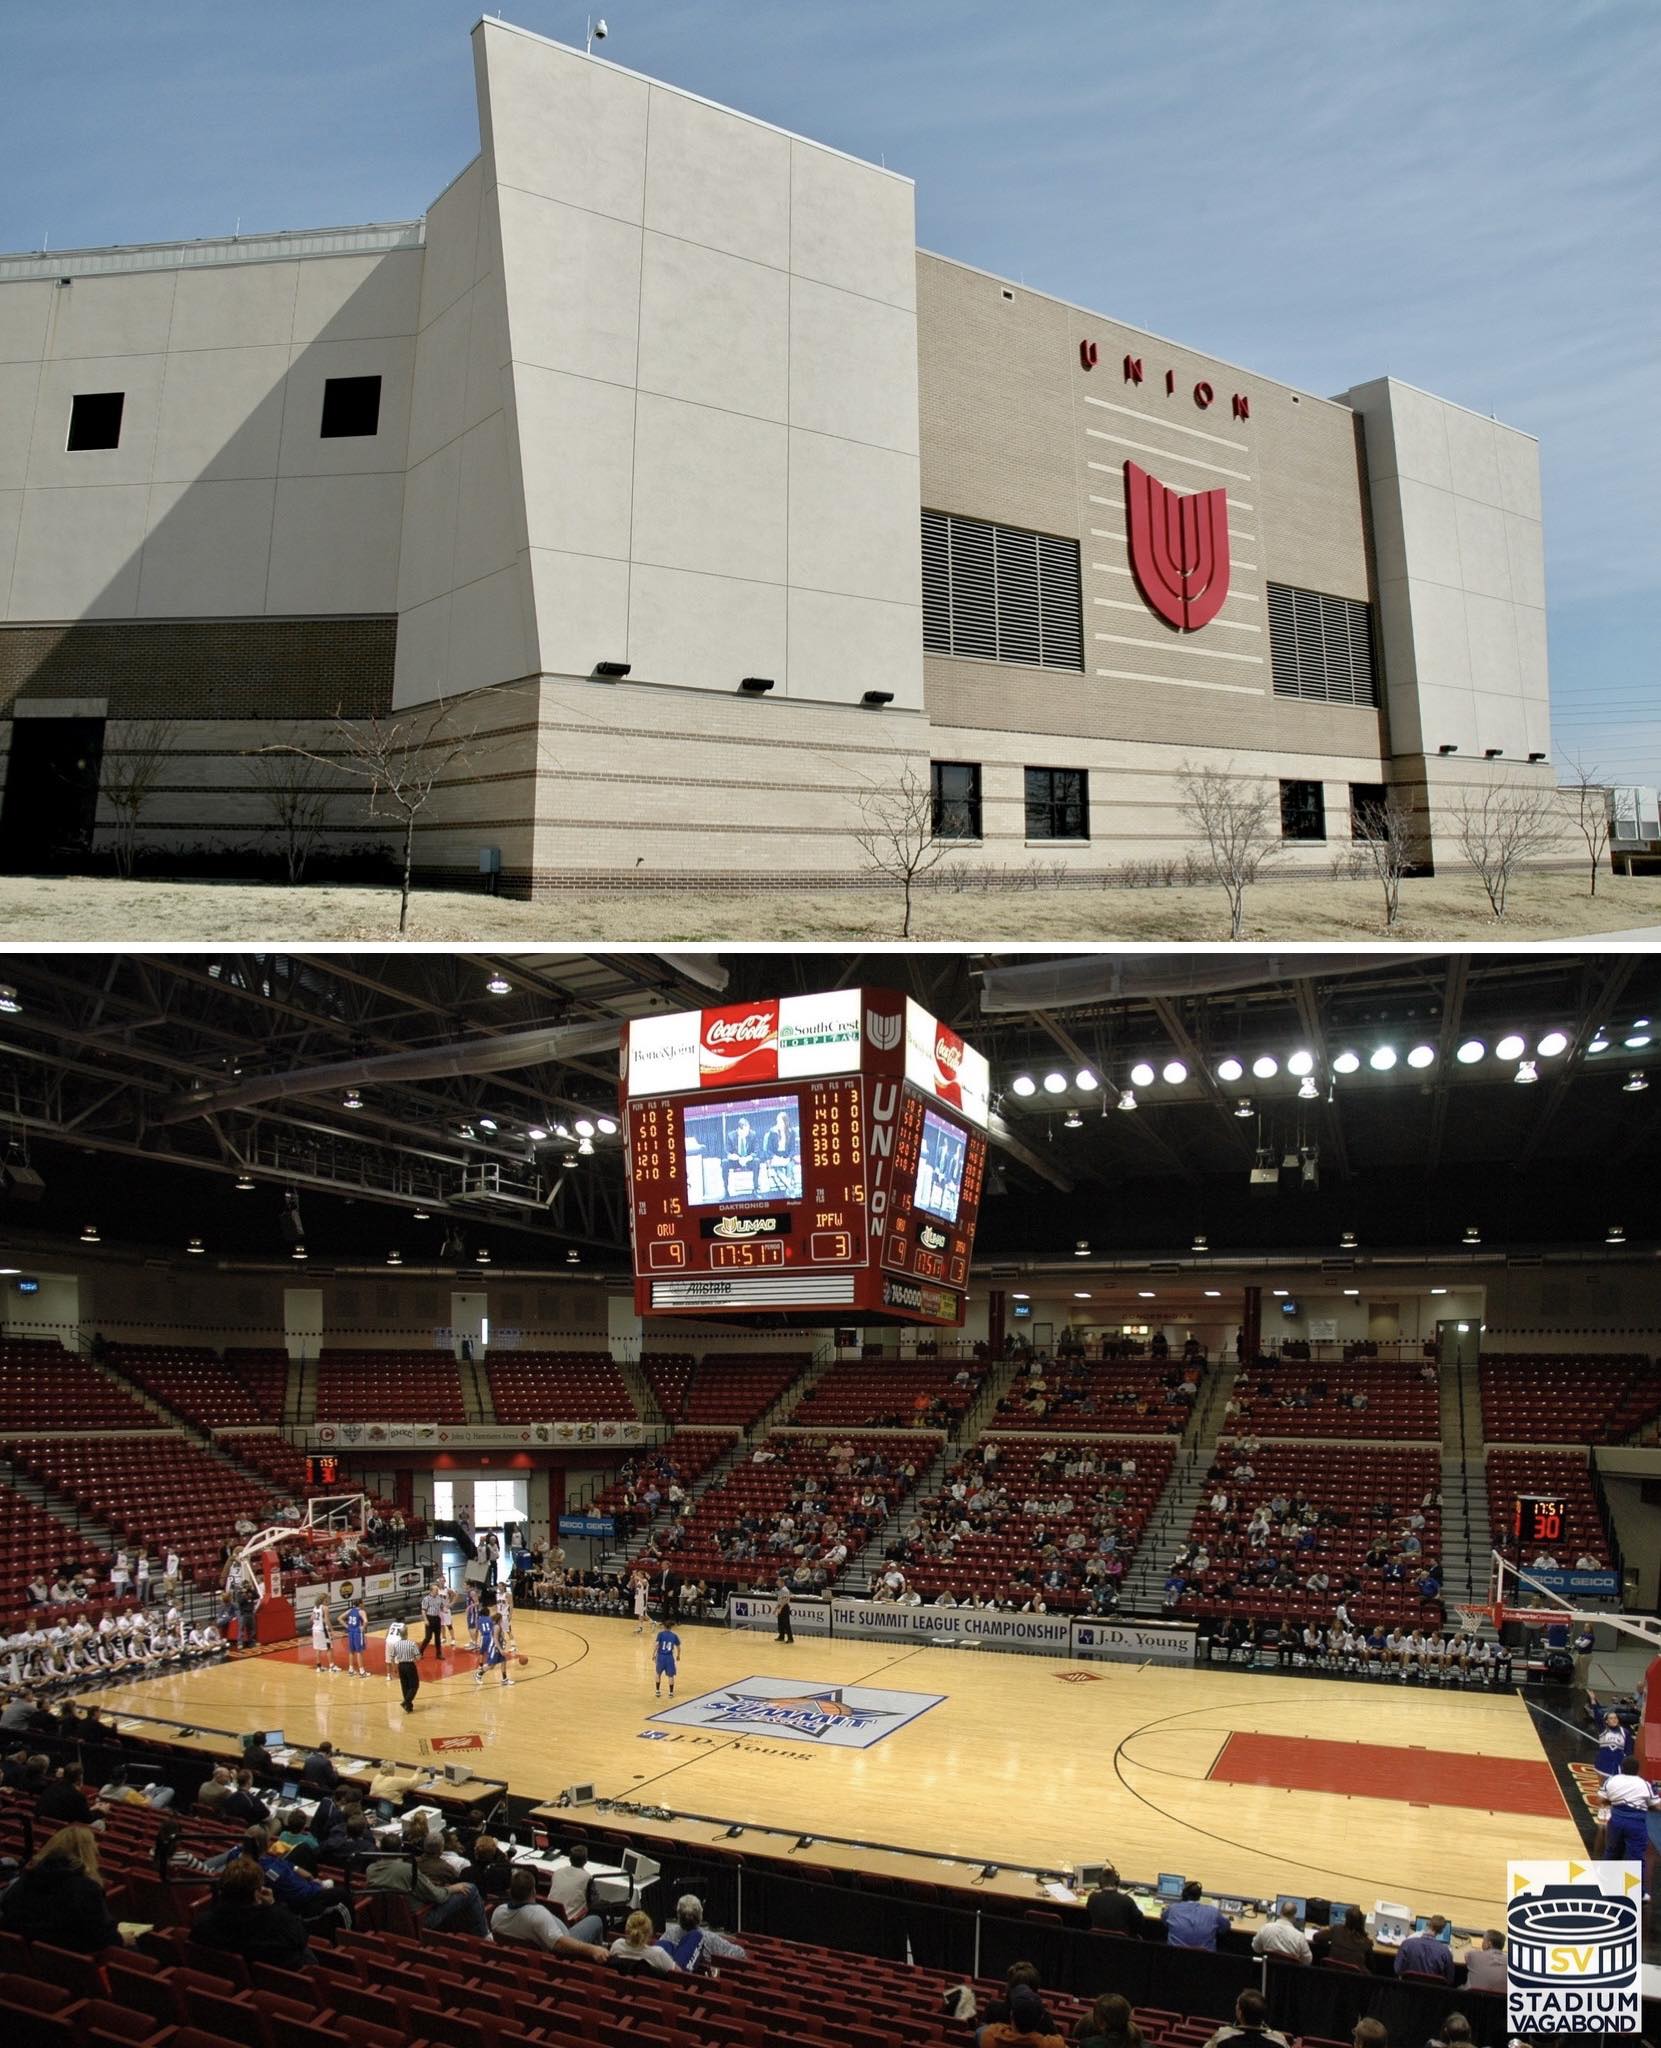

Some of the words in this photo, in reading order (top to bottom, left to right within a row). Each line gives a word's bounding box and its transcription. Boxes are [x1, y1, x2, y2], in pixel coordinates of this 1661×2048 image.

[1080, 340, 1249, 420] UNION
[707, 1013, 774, 1045] Coca-Cola
[795, 1020, 859, 1035] SouthCrest
[780, 1033, 859, 1048] HOSPITAL
[851, 1090, 858, 1103] 3
[667, 1109, 673, 1122] 2
[816, 1109, 827, 1120] 14
[831, 1107, 838, 1119] 0
[851, 1105, 858, 1118] 0
[667, 1124, 674, 1135] 2
[812, 1123, 827, 1136] 23
[832, 1122, 839, 1135] 0
[851, 1121, 859, 1133] 0
[668, 1138, 675, 1150] 0
[814, 1138, 828, 1151] 33
[832, 1138, 839, 1150] 0
[852, 1136, 859, 1148] 0
[638, 1155, 648, 1166] 12
[652, 1154, 659, 1166] 0
[669, 1152, 676, 1164] 3
[814, 1154, 828, 1166] 35
[833, 1153, 840, 1165] 0
[852, 1151, 860, 1163] 0
[871, 1083, 898, 1236] UNION
[669, 1166, 676, 1178] 2
[719, 1202, 769, 1211] DAKTRONICS
[816, 1213, 843, 1227] IPFW
[657, 1223, 675, 1236] ORU
[835, 1236, 846, 1256] 3
[670, 1245, 680, 1263] 9
[720, 1244, 765, 1265] 17:51
[687, 1282, 732, 1294] Allstate
[1534, 1502, 1564, 1515] 17:51
[1534, 1516, 1560, 1538] 30
[1570, 1577, 1615, 1587] GEICO
[789, 1605, 824, 1622] oung
[834, 1609, 855, 1624] THE
[859, 1611, 909, 1629] SUMMIT
[913, 1615, 961, 1632] LEAGUE
[964, 1618, 1068, 1641] CHAMPIONSHIP
[662, 1641, 672, 1651] 14
[1096, 1629, 1129, 1644] J.D.
[1136, 1632, 1189, 1652] Young
[704, 1702, 867, 1728] SUMMIT
[733, 1742, 817, 1761] Young
